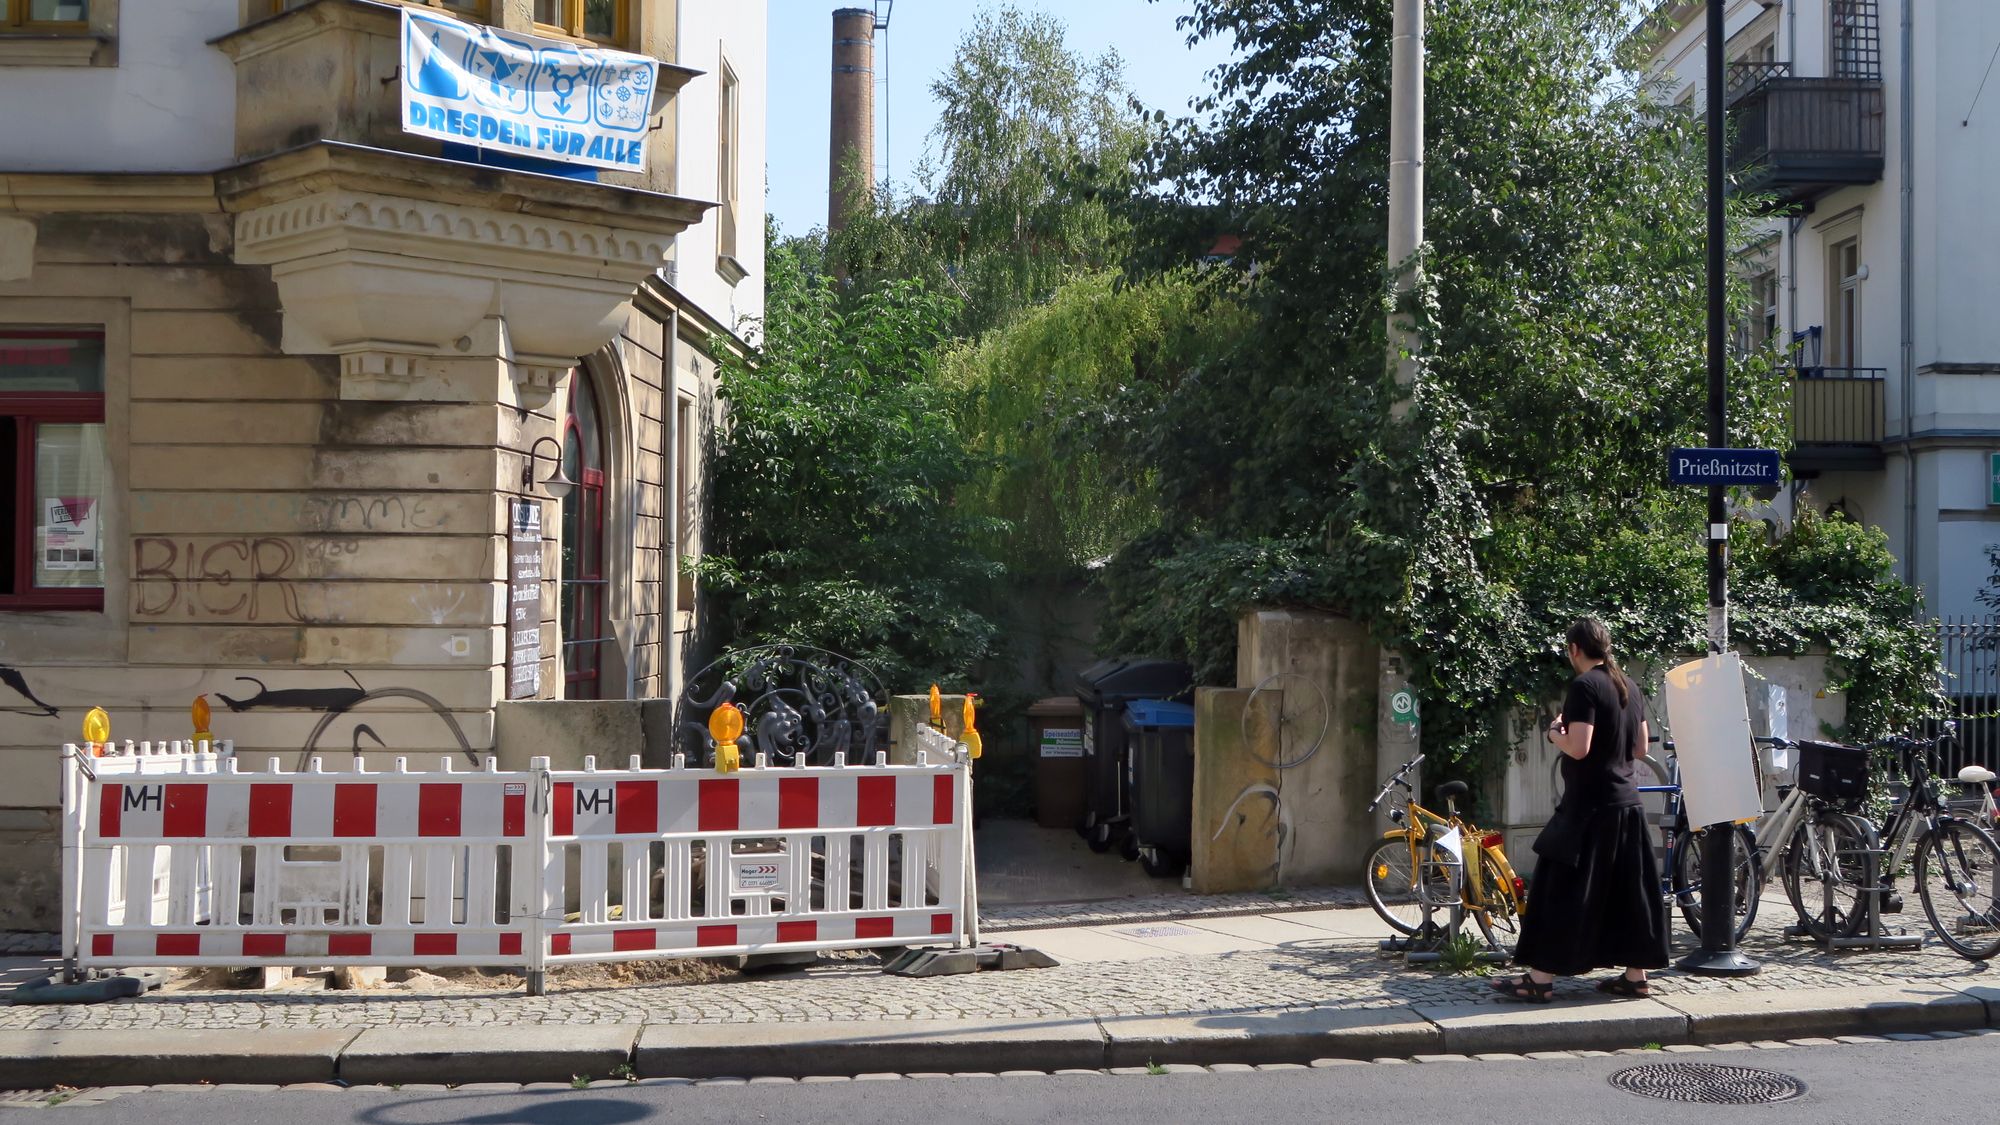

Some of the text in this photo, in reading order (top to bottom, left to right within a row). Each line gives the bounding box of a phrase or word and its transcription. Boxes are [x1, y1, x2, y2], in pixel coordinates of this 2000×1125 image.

[409, 100, 642, 165] DRESDEN FÜR ALLE
[1678, 458, 1772, 477] Prießnitzstr.
[135, 537, 304, 622] BIER
[123, 785, 163, 812] MH
[576, 788, 613, 815] MH
